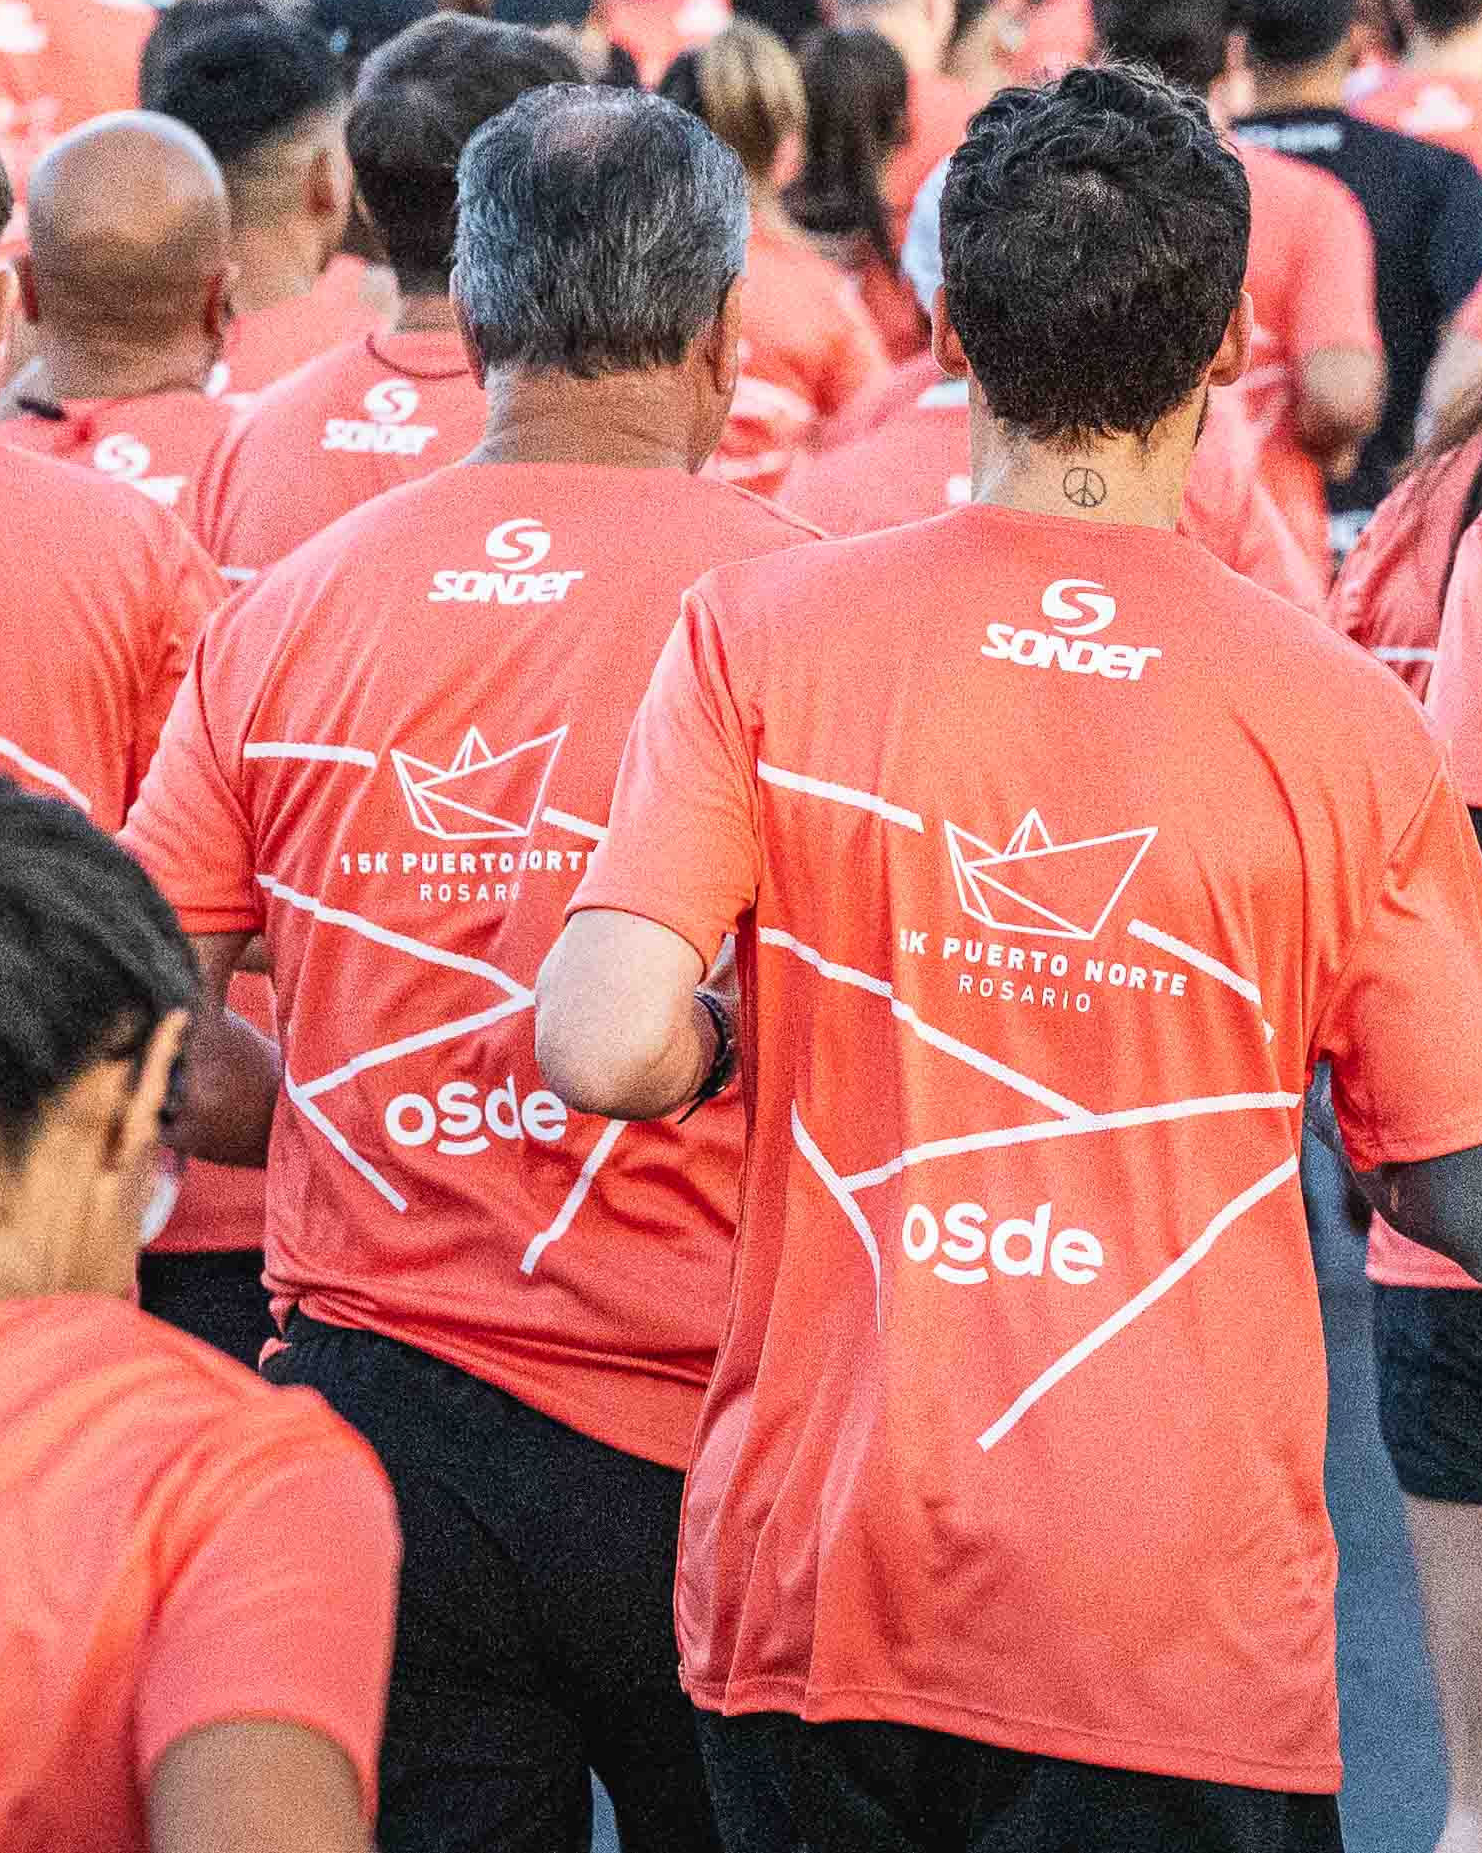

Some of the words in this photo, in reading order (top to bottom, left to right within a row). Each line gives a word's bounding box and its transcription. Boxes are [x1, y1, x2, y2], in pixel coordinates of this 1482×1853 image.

[340, 852, 389, 875] 15K
[402, 852, 514, 874] PUERTO
[942, 937, 1069, 978] PUERTO
[1085, 959, 1188, 997] NORTE
[958, 974, 1091, 1013] ROSARIO
[385, 1075, 567, 1156] osde
[902, 1202, 1104, 1285] osde
